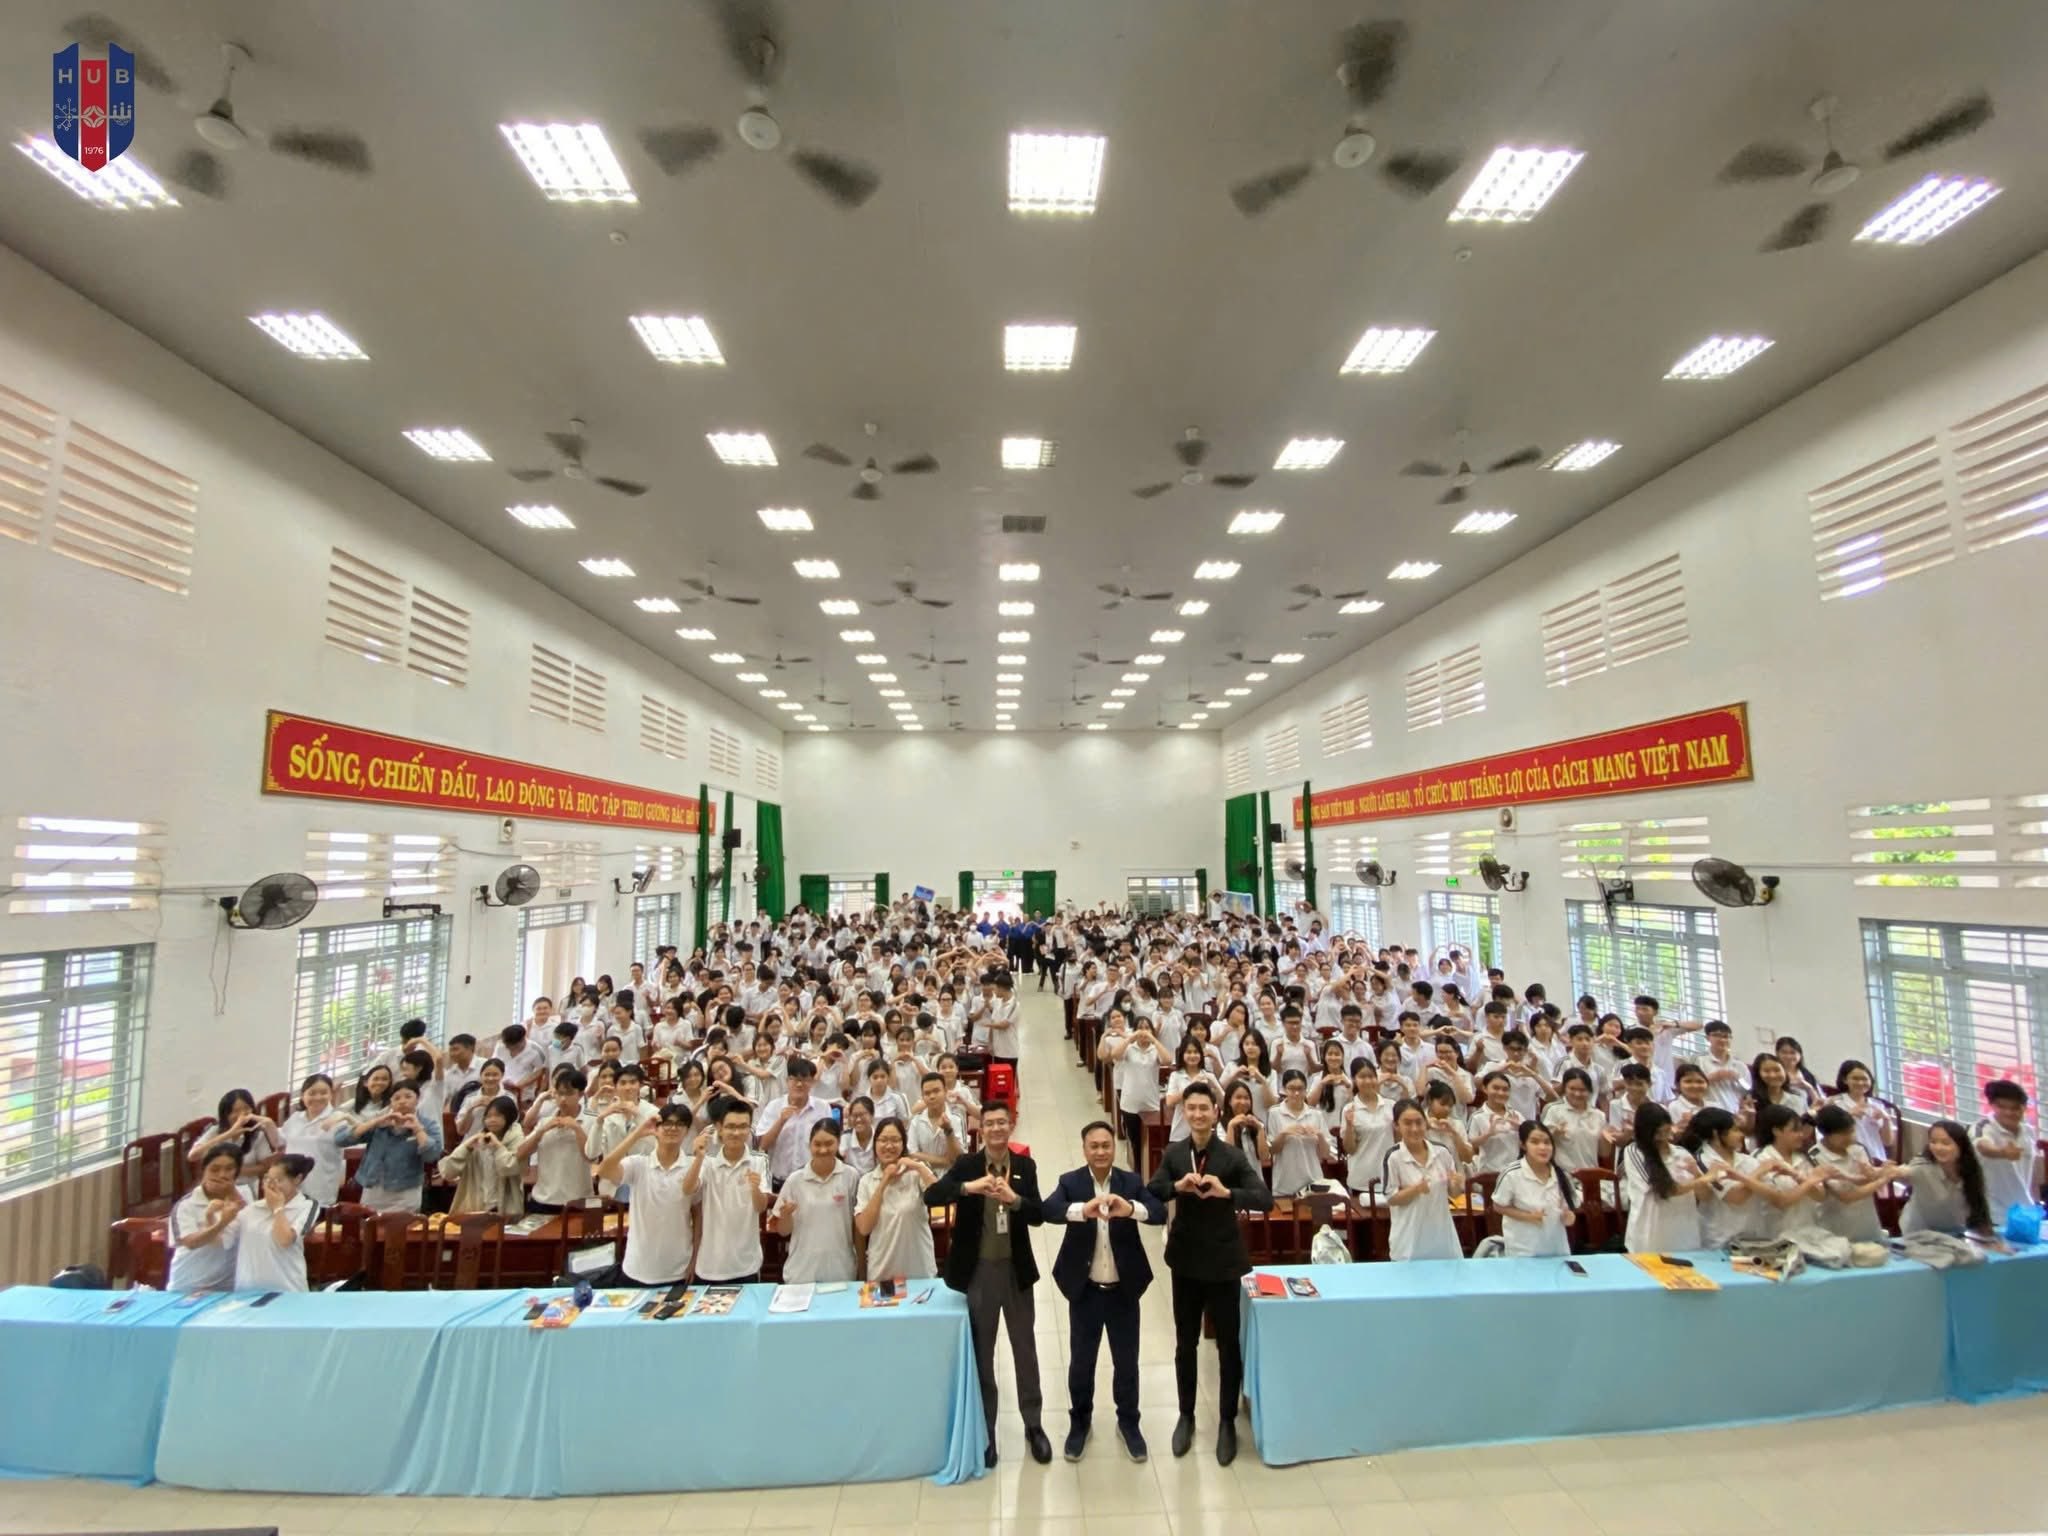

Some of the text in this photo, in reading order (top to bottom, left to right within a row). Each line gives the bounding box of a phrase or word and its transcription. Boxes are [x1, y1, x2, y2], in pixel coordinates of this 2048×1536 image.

[289, 733, 366, 791] SỐNG,
[368, 752, 435, 794] CHIẾN
[440, 760, 480, 803] ĐẤU,
[486, 777, 514, 803] LAO
[519, 778, 554, 812] ĐỘNG
[558, 785, 574, 811] VÀ
[577, 792, 599, 817] HỌC
[601, 792, 620, 820] TẬP
[622, 799, 644, 819] THEO
[1414, 776, 1424, 807] TỔ
[1425, 779, 1449, 805] CHỨC
[1450, 780, 1467, 806] MỌI
[1469, 765, 1503, 800] THẮNG
[1505, 767, 1523, 799] LỢI
[1526, 757, 1551, 793] CỦA
[1552, 756, 1589, 788] CÁCH
[1593, 751, 1636, 788] MẠNG
[1639, 737, 1680, 781] VIỆT
[1684, 734, 1730, 771] NAM
